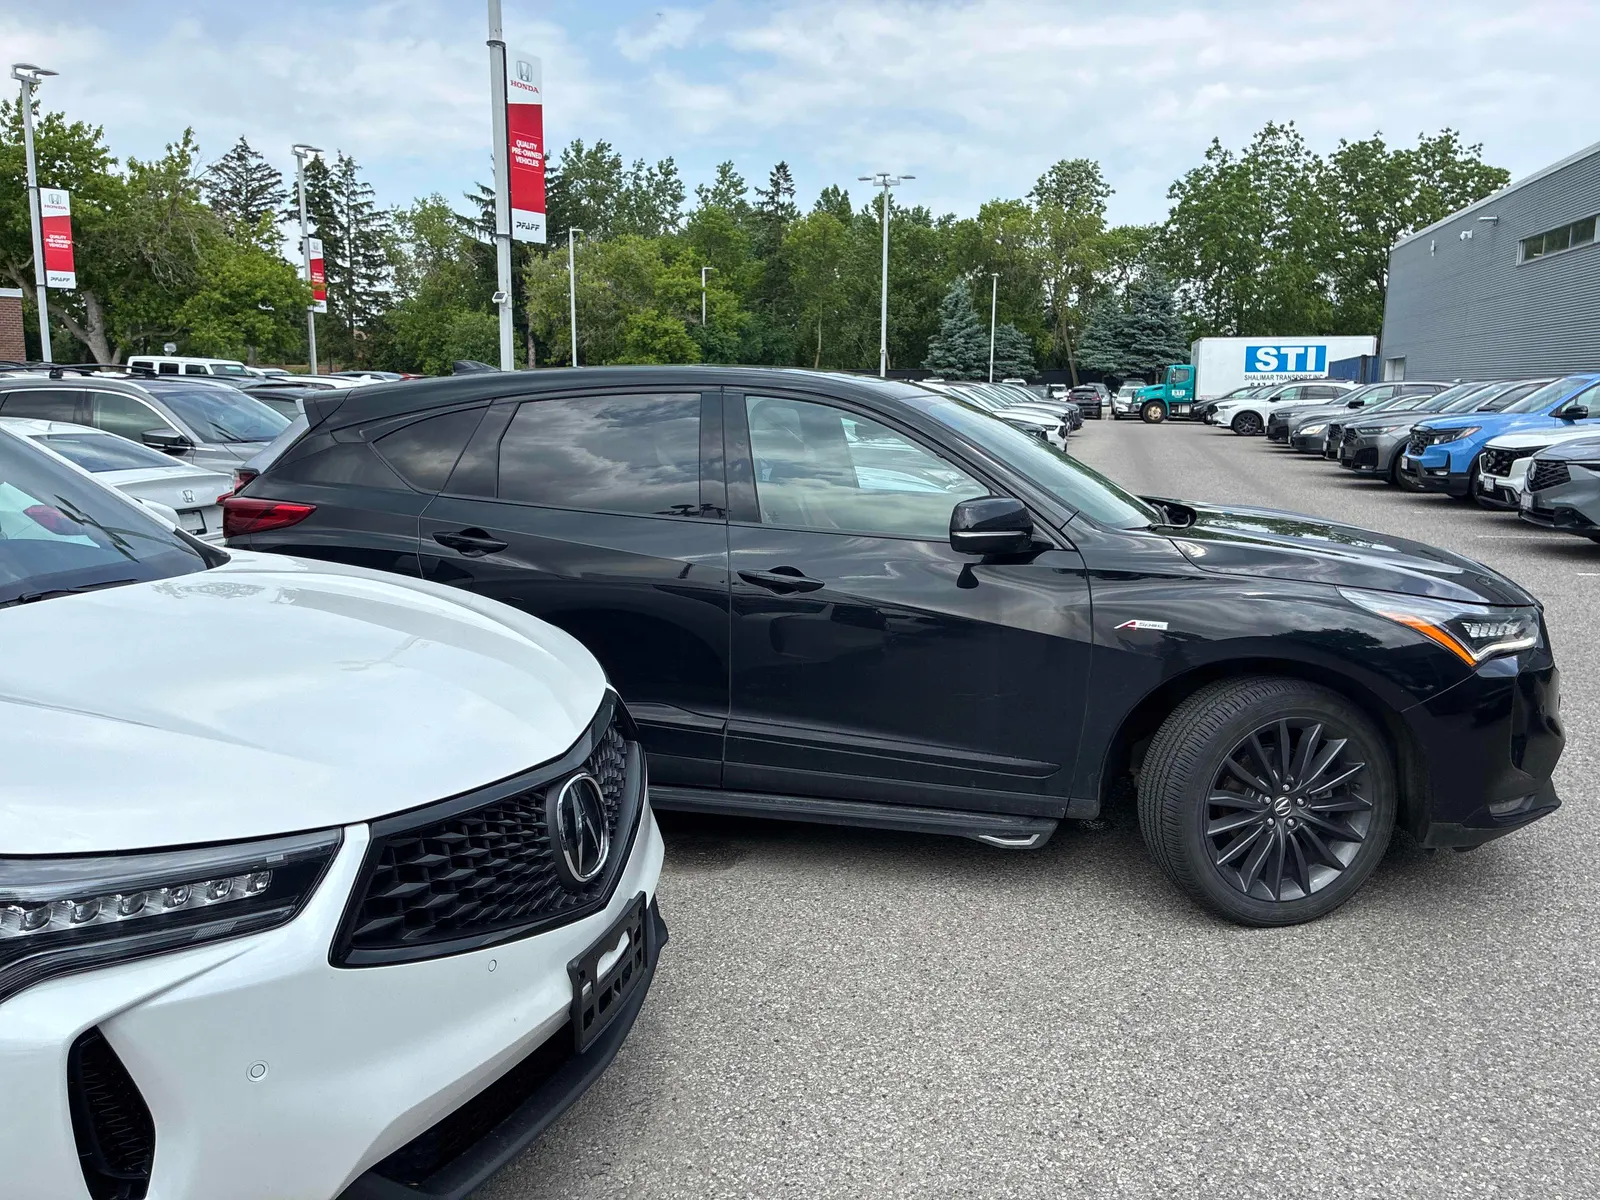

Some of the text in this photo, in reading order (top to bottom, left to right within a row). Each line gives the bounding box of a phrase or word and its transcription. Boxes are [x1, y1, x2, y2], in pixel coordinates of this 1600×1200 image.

[510, 80, 539, 93] HONDA
[516, 139, 537, 151] QUALITY
[511, 146, 542, 159] PRE-OWNED
[515, 156, 539, 167] VEHICLES
[516, 221, 540, 231] PFAFF
[1254, 346, 1317, 371] STI
